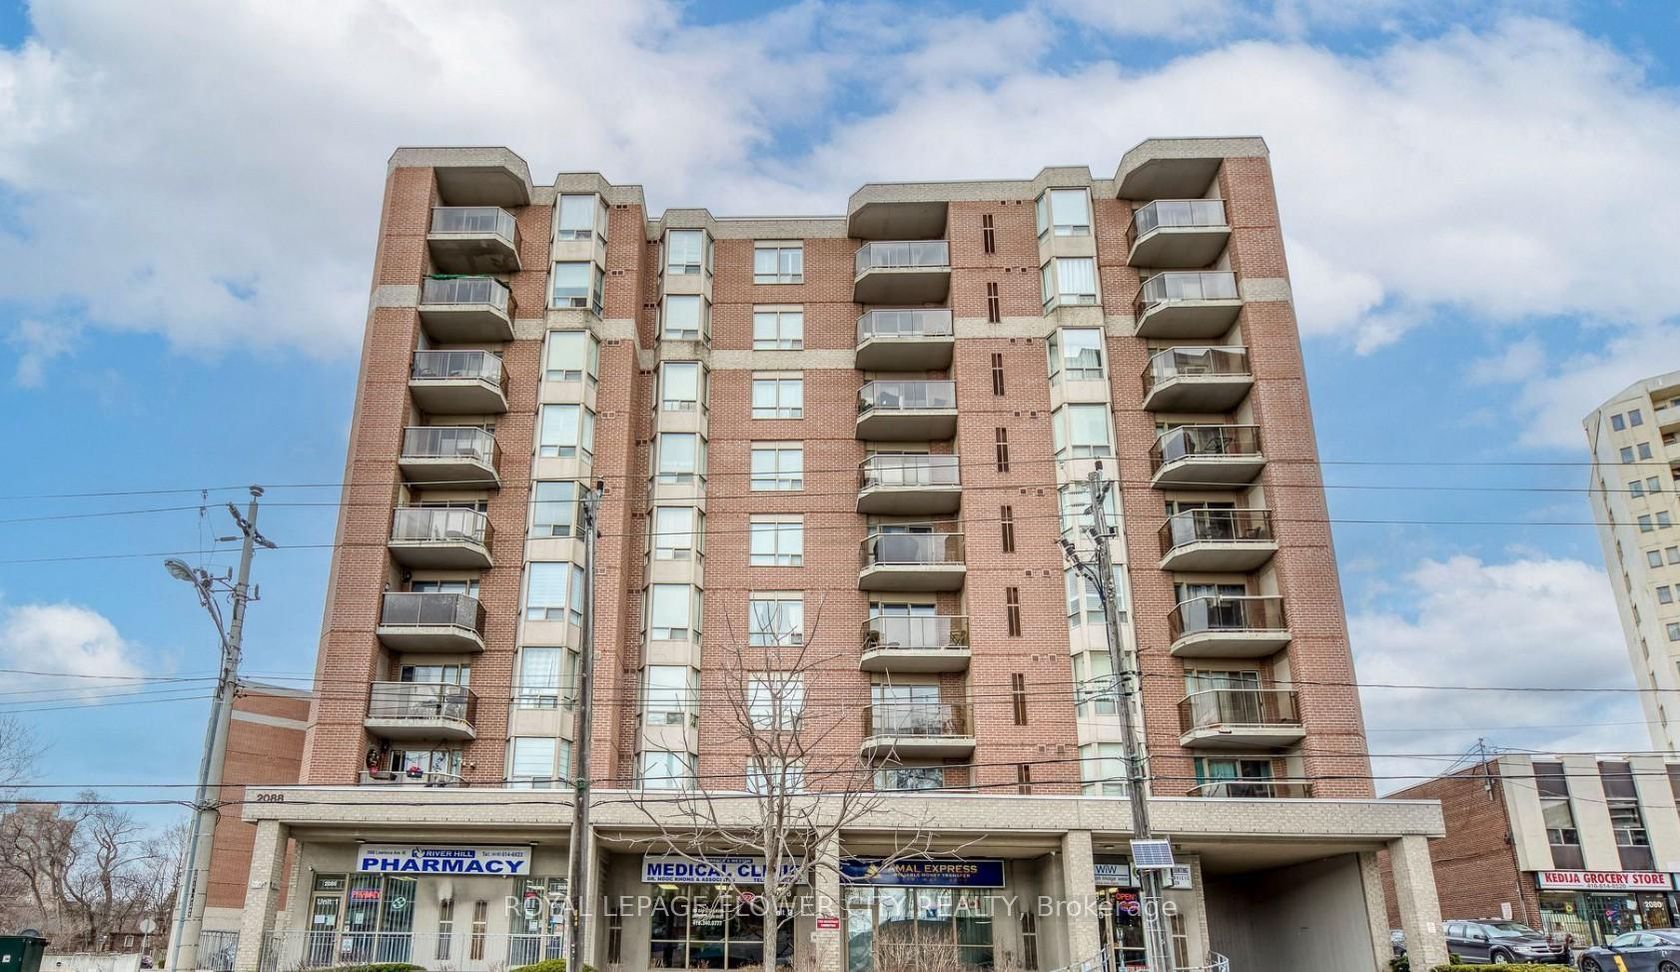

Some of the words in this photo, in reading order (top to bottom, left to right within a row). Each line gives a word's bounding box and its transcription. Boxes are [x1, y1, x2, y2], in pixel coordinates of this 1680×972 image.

[361, 858, 525, 873] PHARMACY
[646, 863, 732, 877] MEDICAL
[924, 864, 978, 873] EXPRESS
[1545, 872, 1581, 884] KEDIJA
[1584, 872, 1630, 884] GROCERY
[1632, 873, 1665, 885] STORE
[317, 898, 332, 906] Unit
